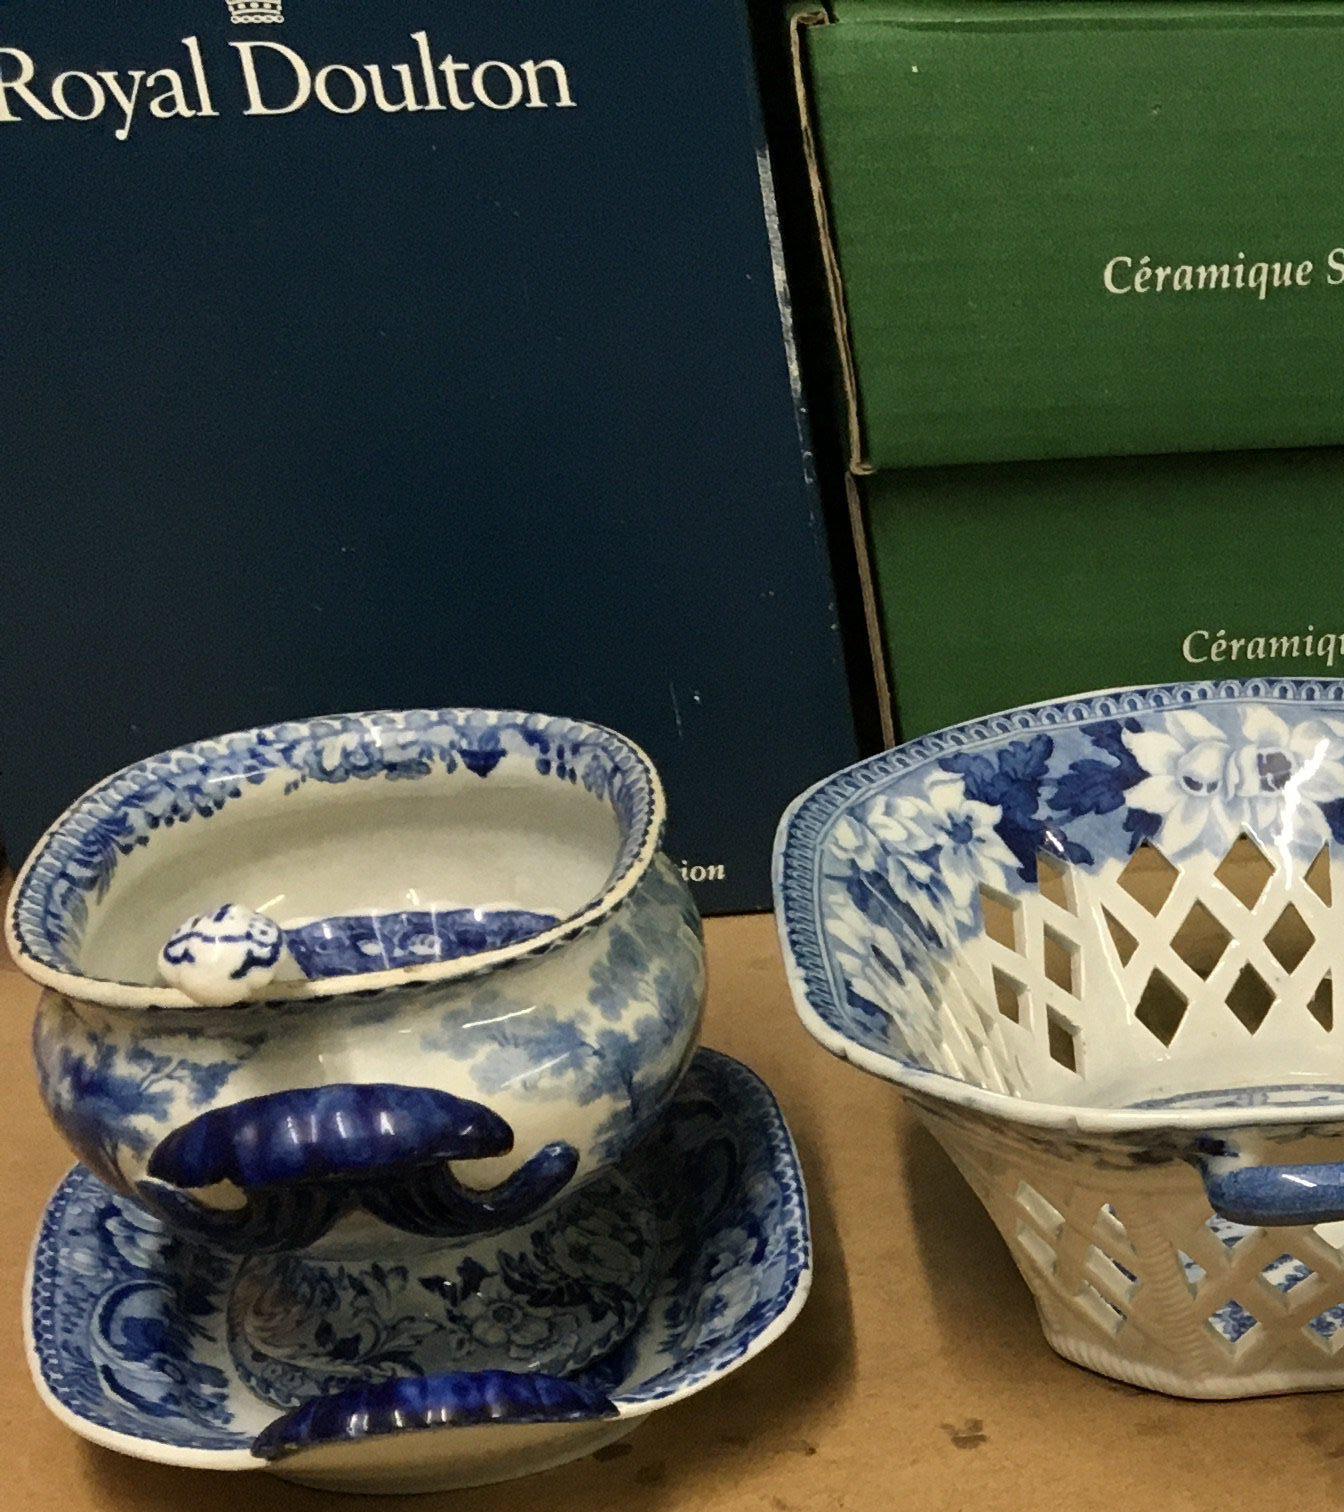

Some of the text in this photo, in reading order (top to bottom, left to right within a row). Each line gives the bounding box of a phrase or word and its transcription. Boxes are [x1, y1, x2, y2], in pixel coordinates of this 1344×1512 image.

[0, 30, 578, 141] Royal Doulton
[1103, 250, 1313, 300] Céramique
[680, 859, 726, 882] ion
